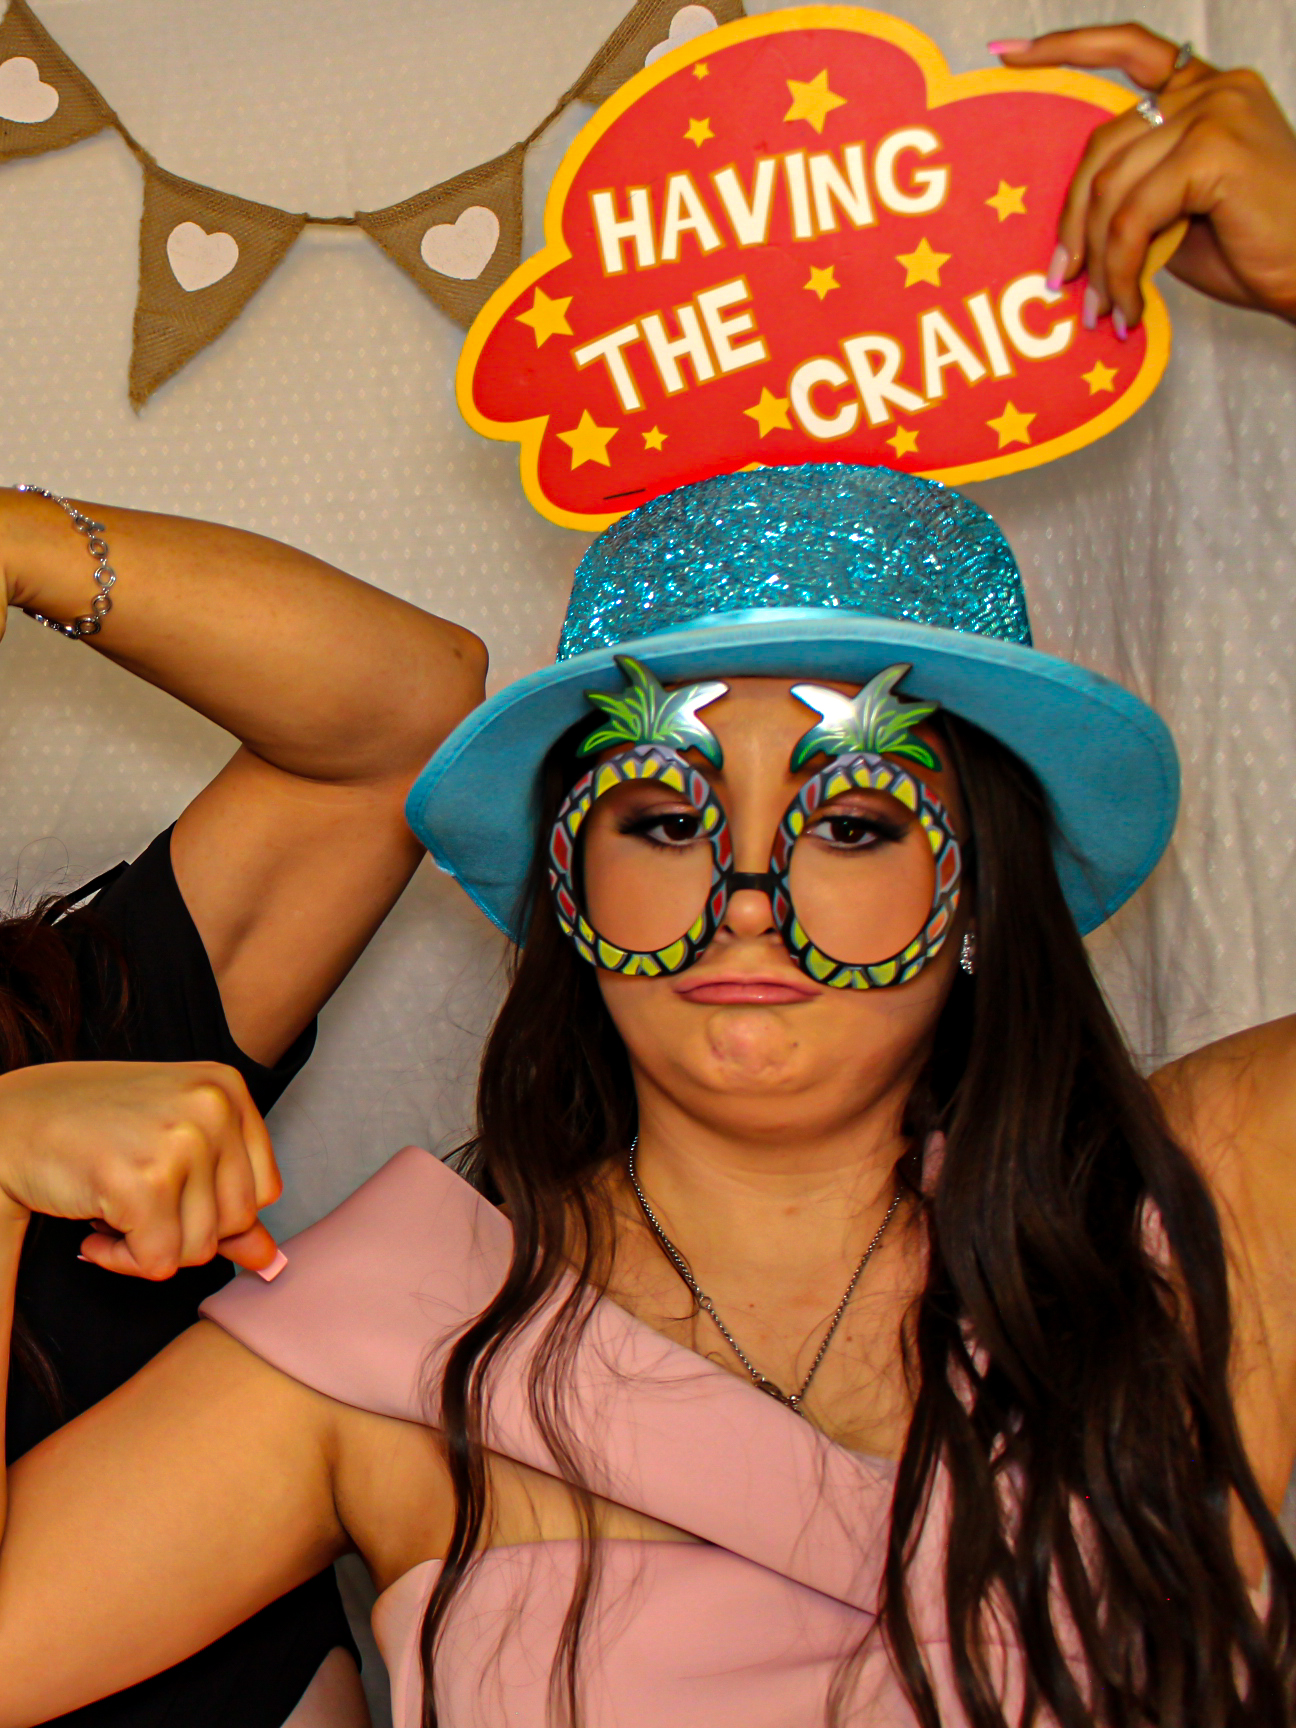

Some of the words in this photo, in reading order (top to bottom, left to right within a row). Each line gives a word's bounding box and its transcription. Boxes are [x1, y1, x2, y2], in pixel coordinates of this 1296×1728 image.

[592, 128, 947, 273] HAVING
[575, 280, 766, 410] THE
[790, 274, 1074, 439] CRAIC
